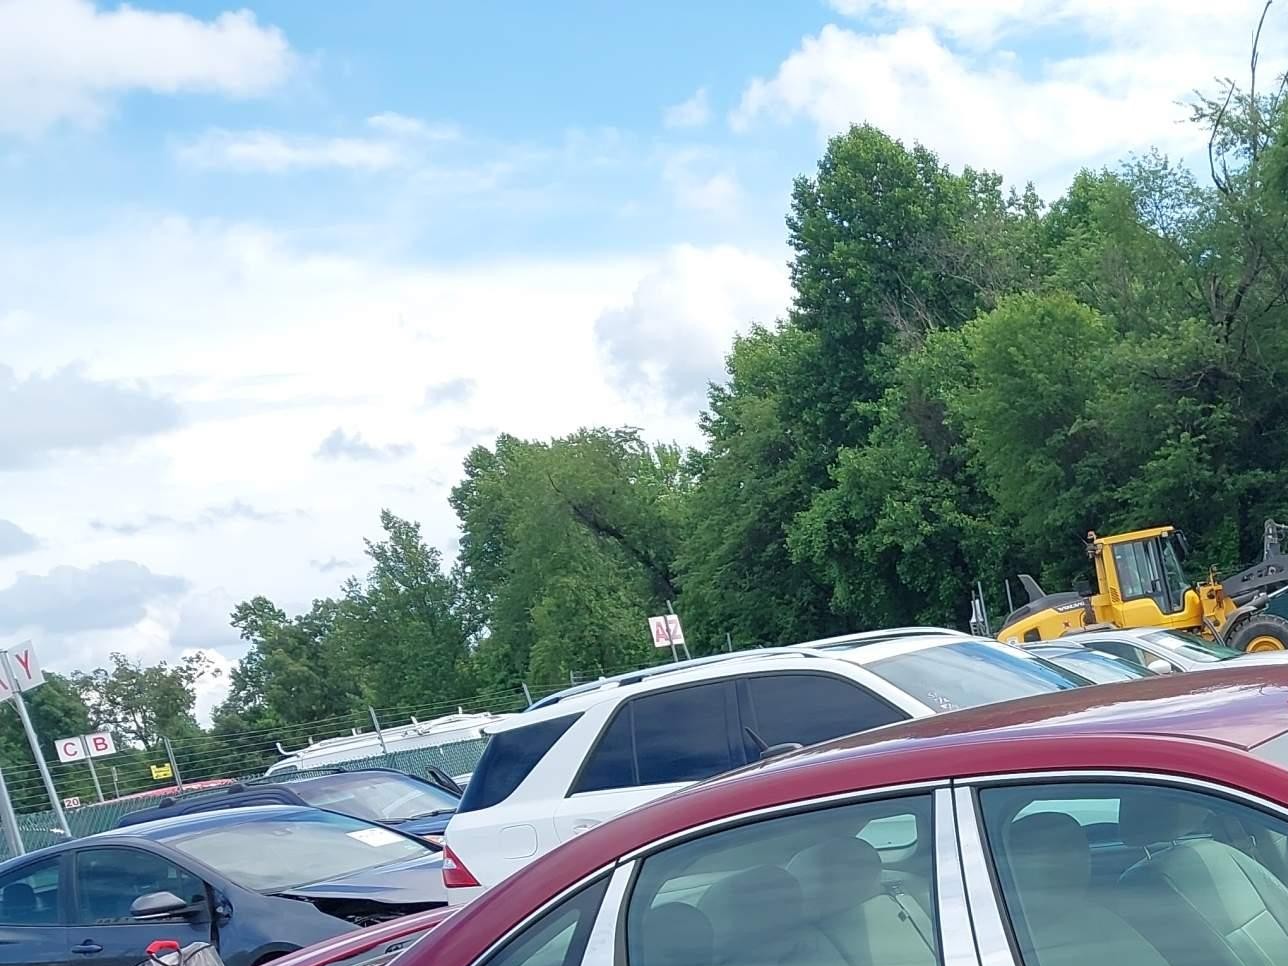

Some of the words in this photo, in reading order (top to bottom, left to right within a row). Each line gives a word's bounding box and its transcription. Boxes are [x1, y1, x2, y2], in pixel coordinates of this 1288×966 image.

[15, 649, 32, 680] Y
[63, 741, 78, 757] C
[92, 736, 108, 752] B
[65, 798, 79, 808] 20
